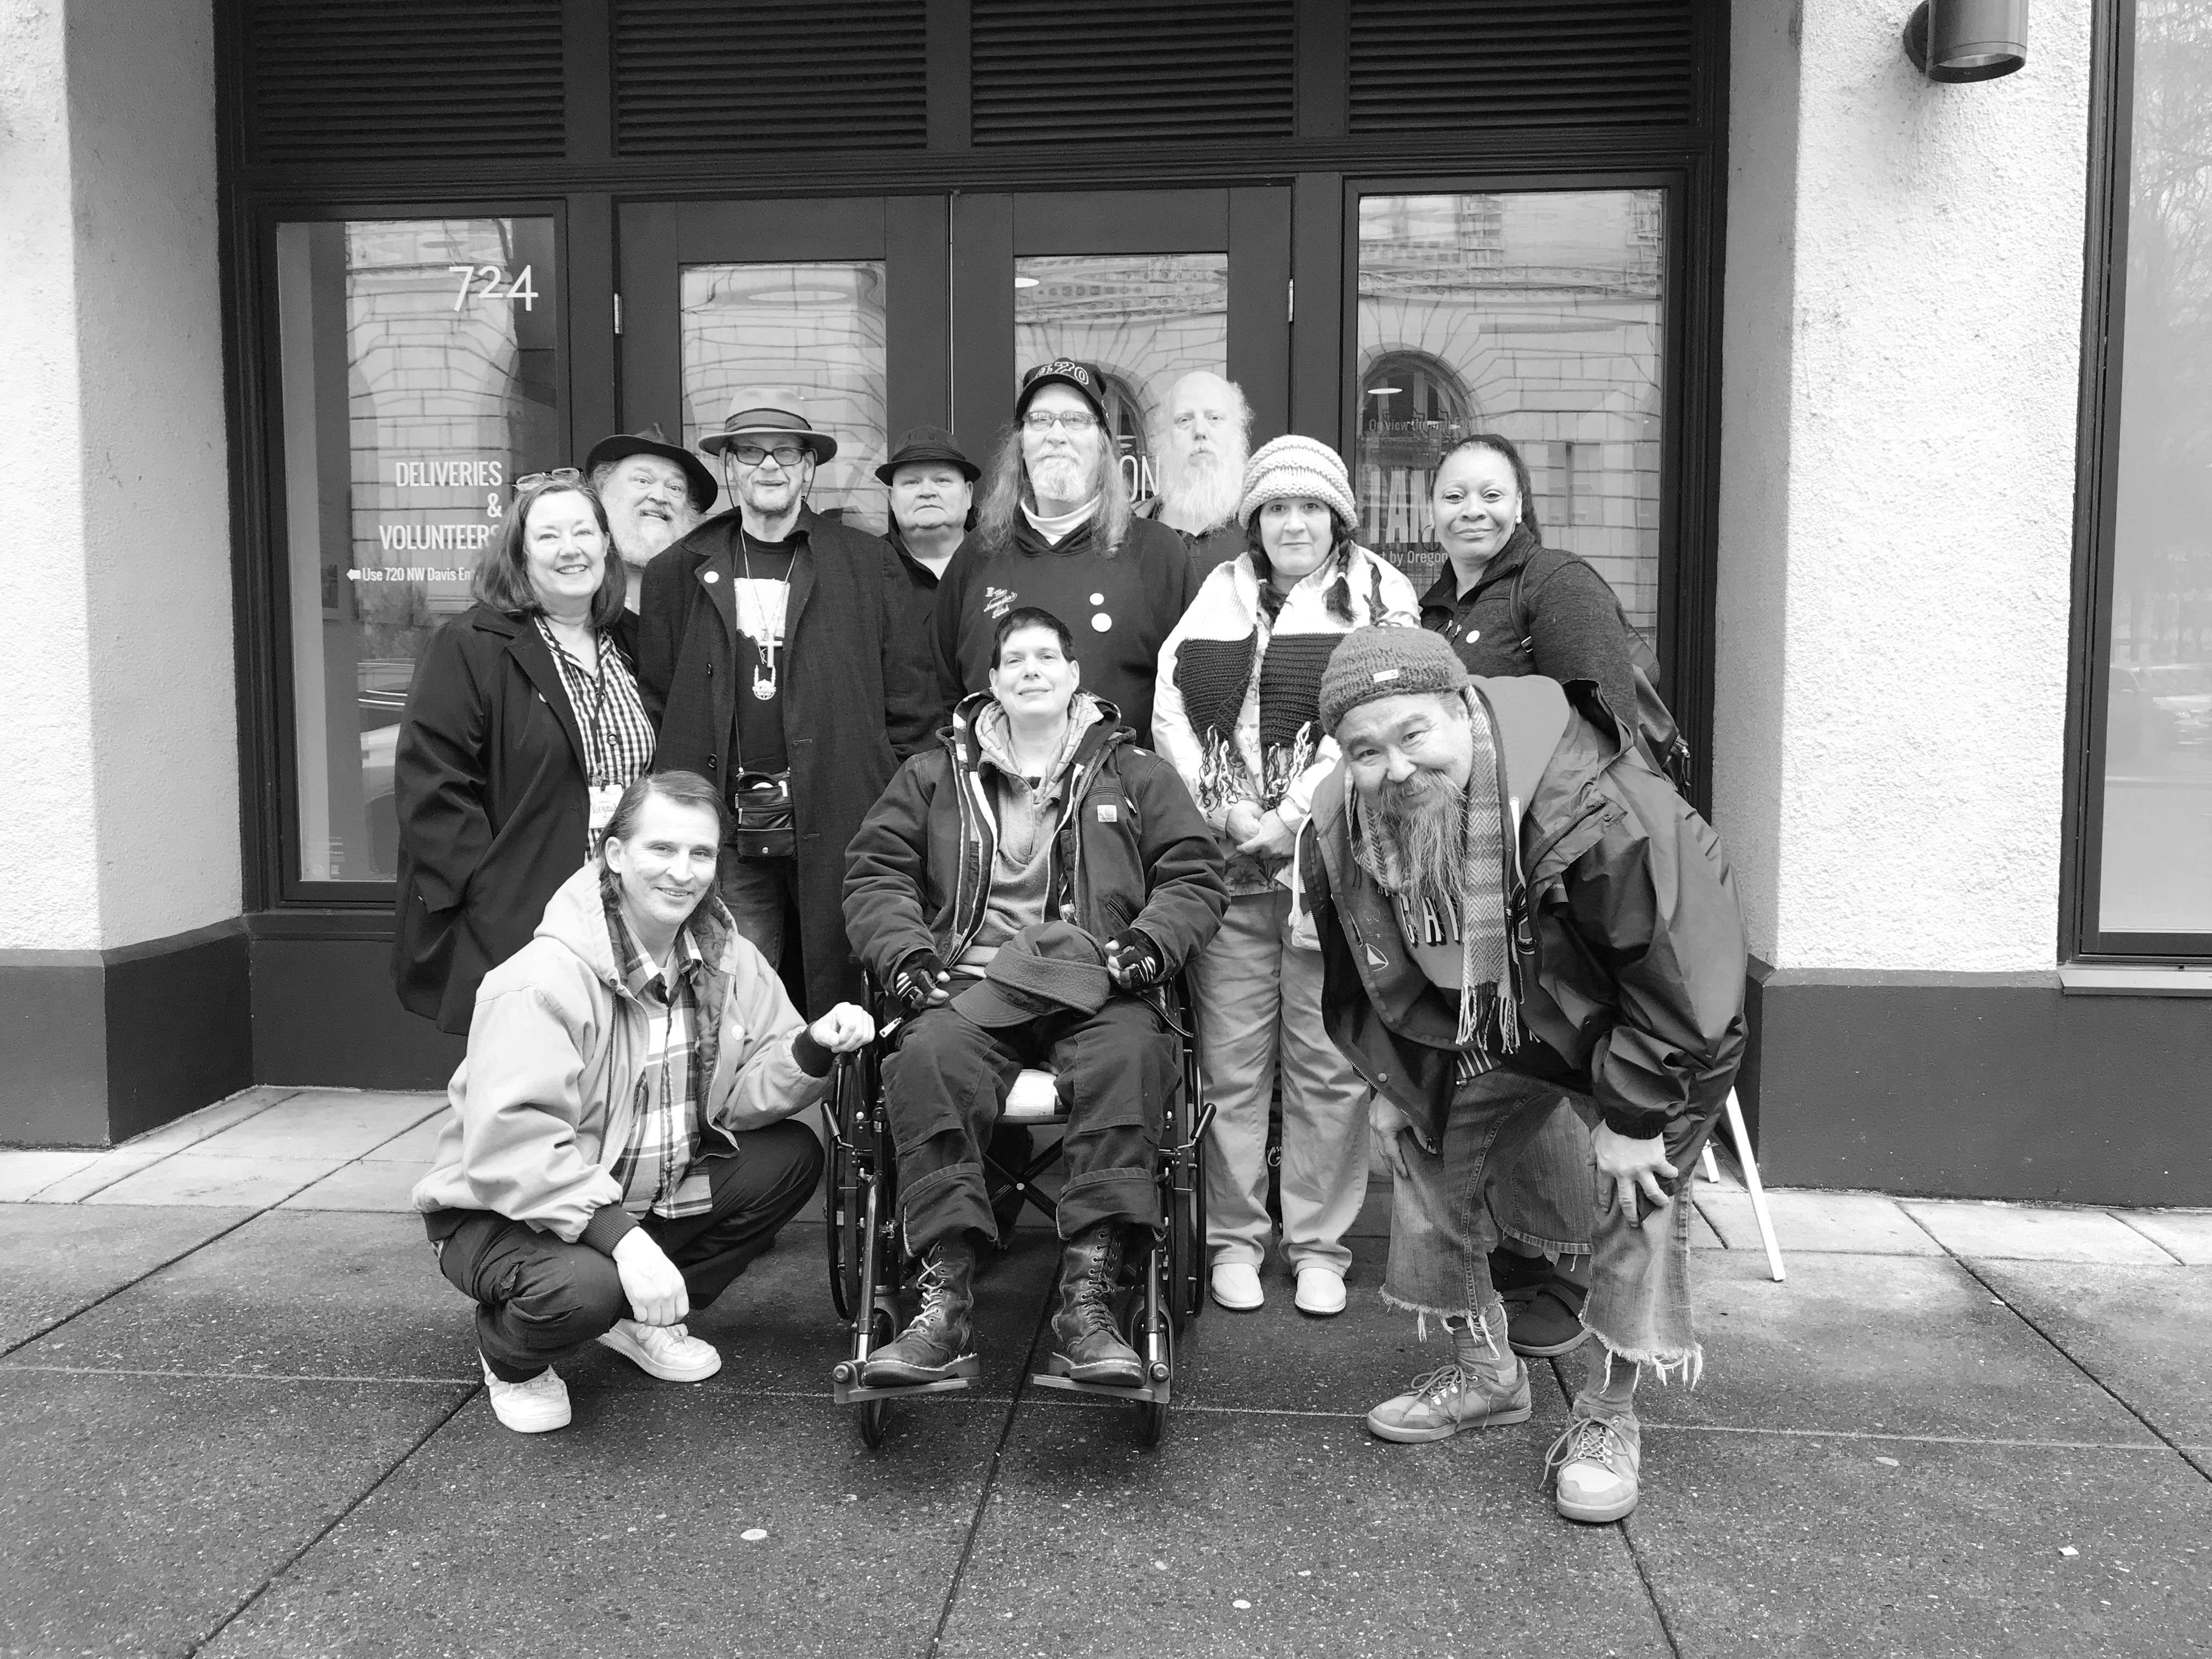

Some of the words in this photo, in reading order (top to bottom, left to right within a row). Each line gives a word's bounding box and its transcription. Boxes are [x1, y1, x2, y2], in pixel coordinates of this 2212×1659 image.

[449, 264, 539, 312] 724
[396, 461, 503, 487] DELIVERIES
[487, 493, 503, 518] &
[1390, 550, 1403, 567] by
[1407, 550, 1448, 567] Oregon
[362, 567, 383, 582] Use
[385, 567, 405, 581] 720
[407, 567, 425, 581] NW
[427, 567, 456, 582] Davis
[458, 566, 474, 582] En
